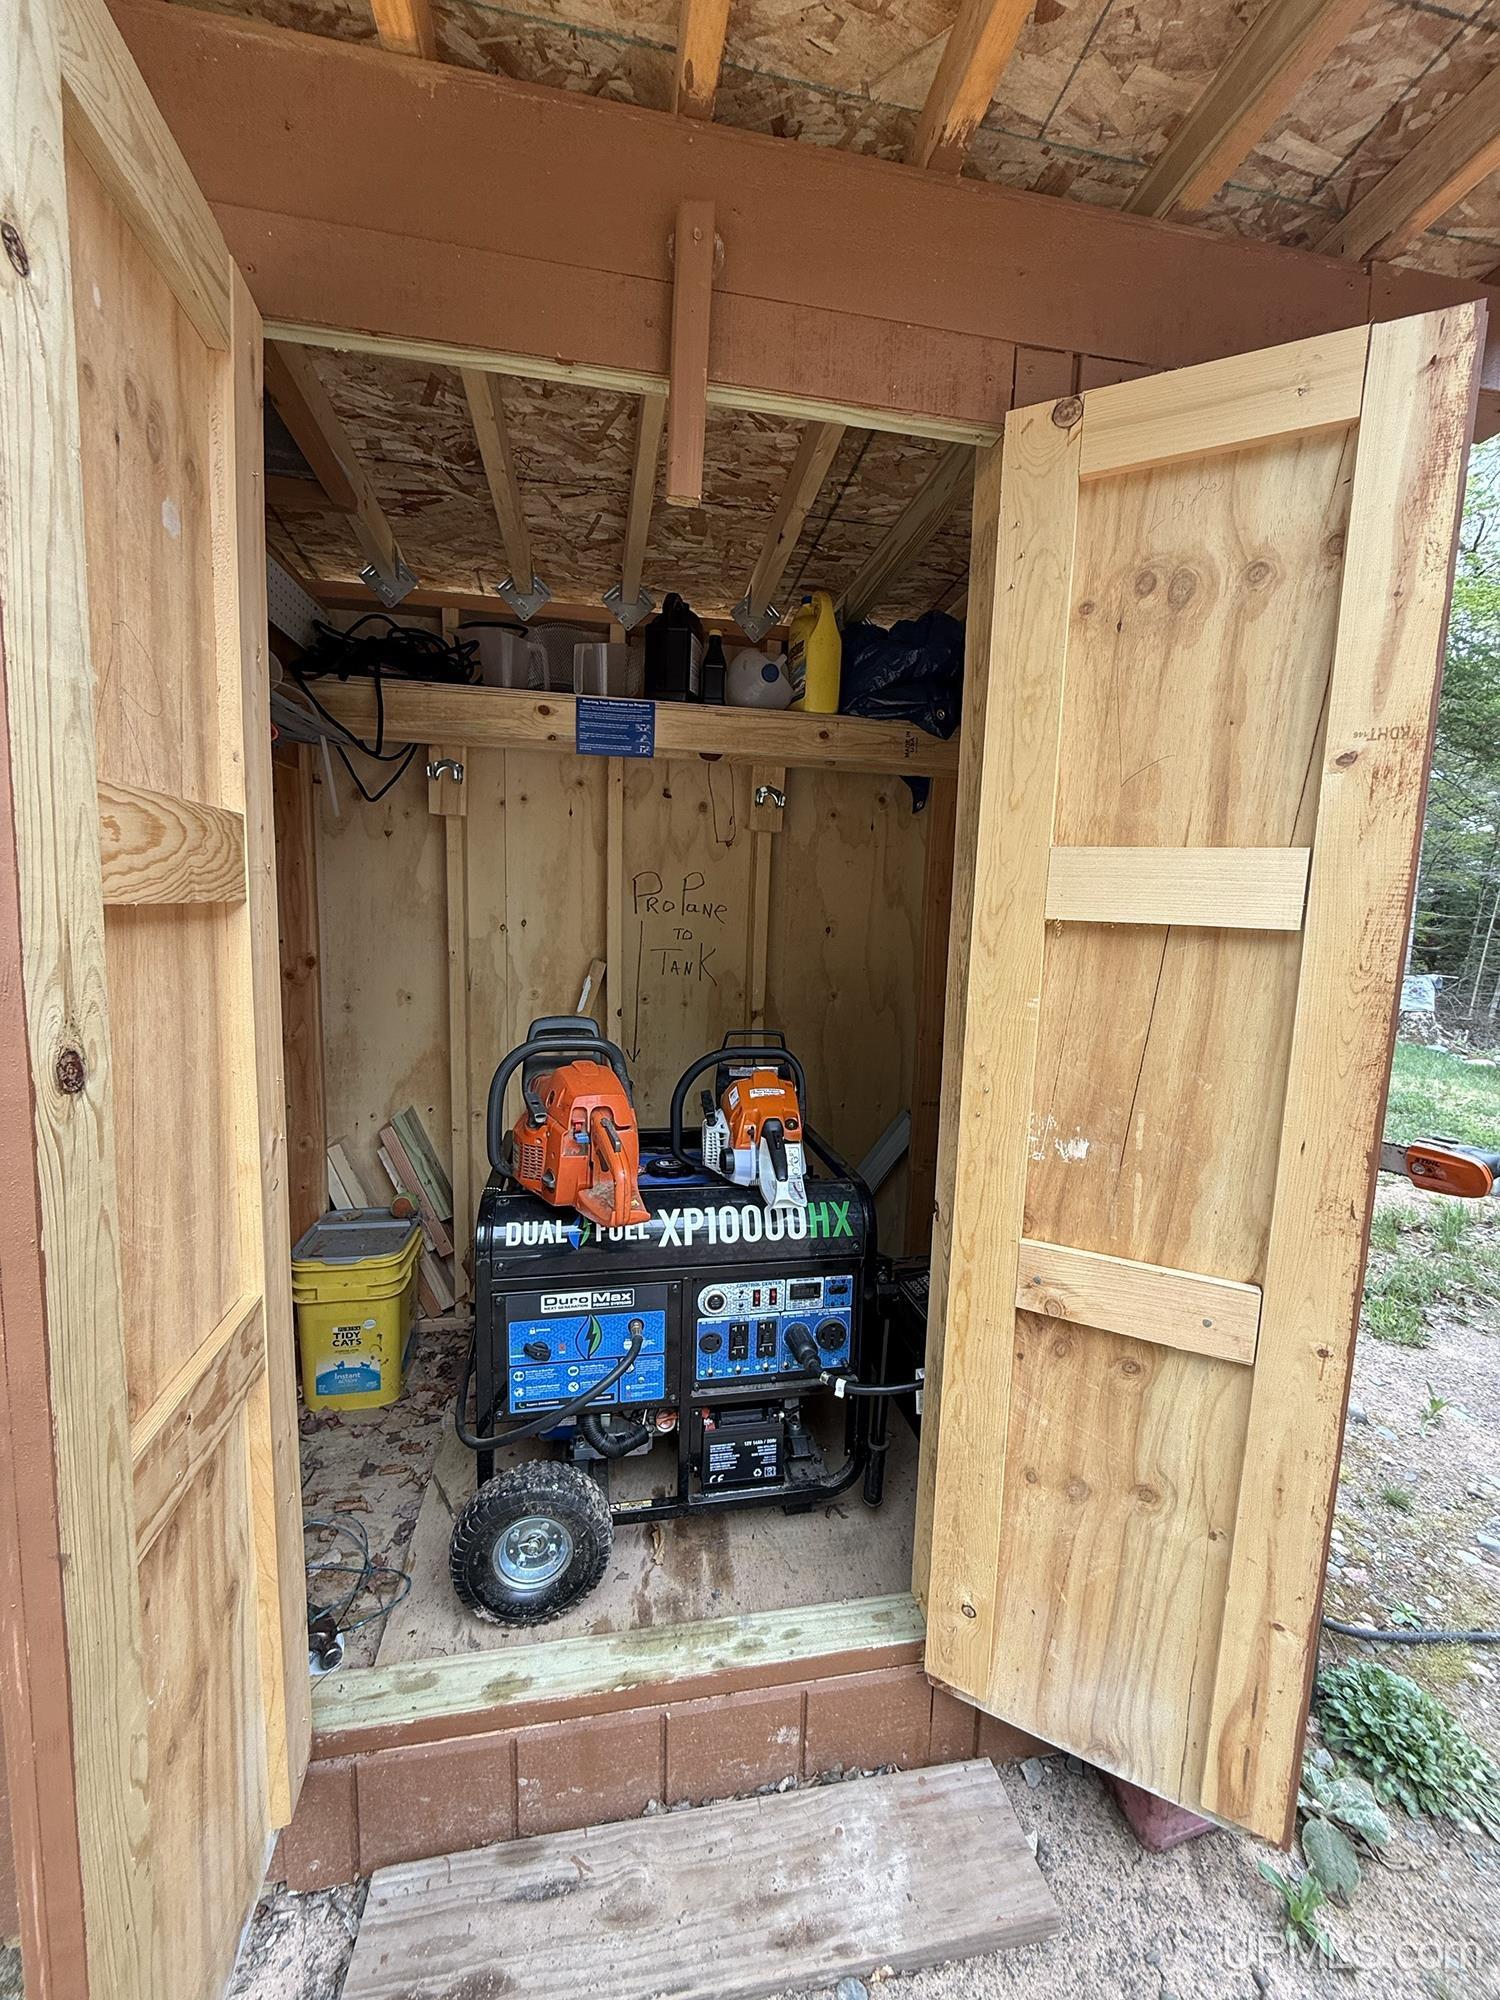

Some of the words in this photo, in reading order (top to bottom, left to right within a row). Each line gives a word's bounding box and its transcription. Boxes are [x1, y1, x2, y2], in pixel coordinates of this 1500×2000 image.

[673, 928, 693, 940] TO
[650, 942, 718, 987] TANK
[1415, 1157, 1440, 1167] STIHL
[505, 1220, 567, 1247] DUAL
[595, 1221, 650, 1242] FUEL
[333, 1331, 360, 1339] TIDY
[332, 1338, 362, 1347] CATS
[334, 1372, 361, 1380] Instant
